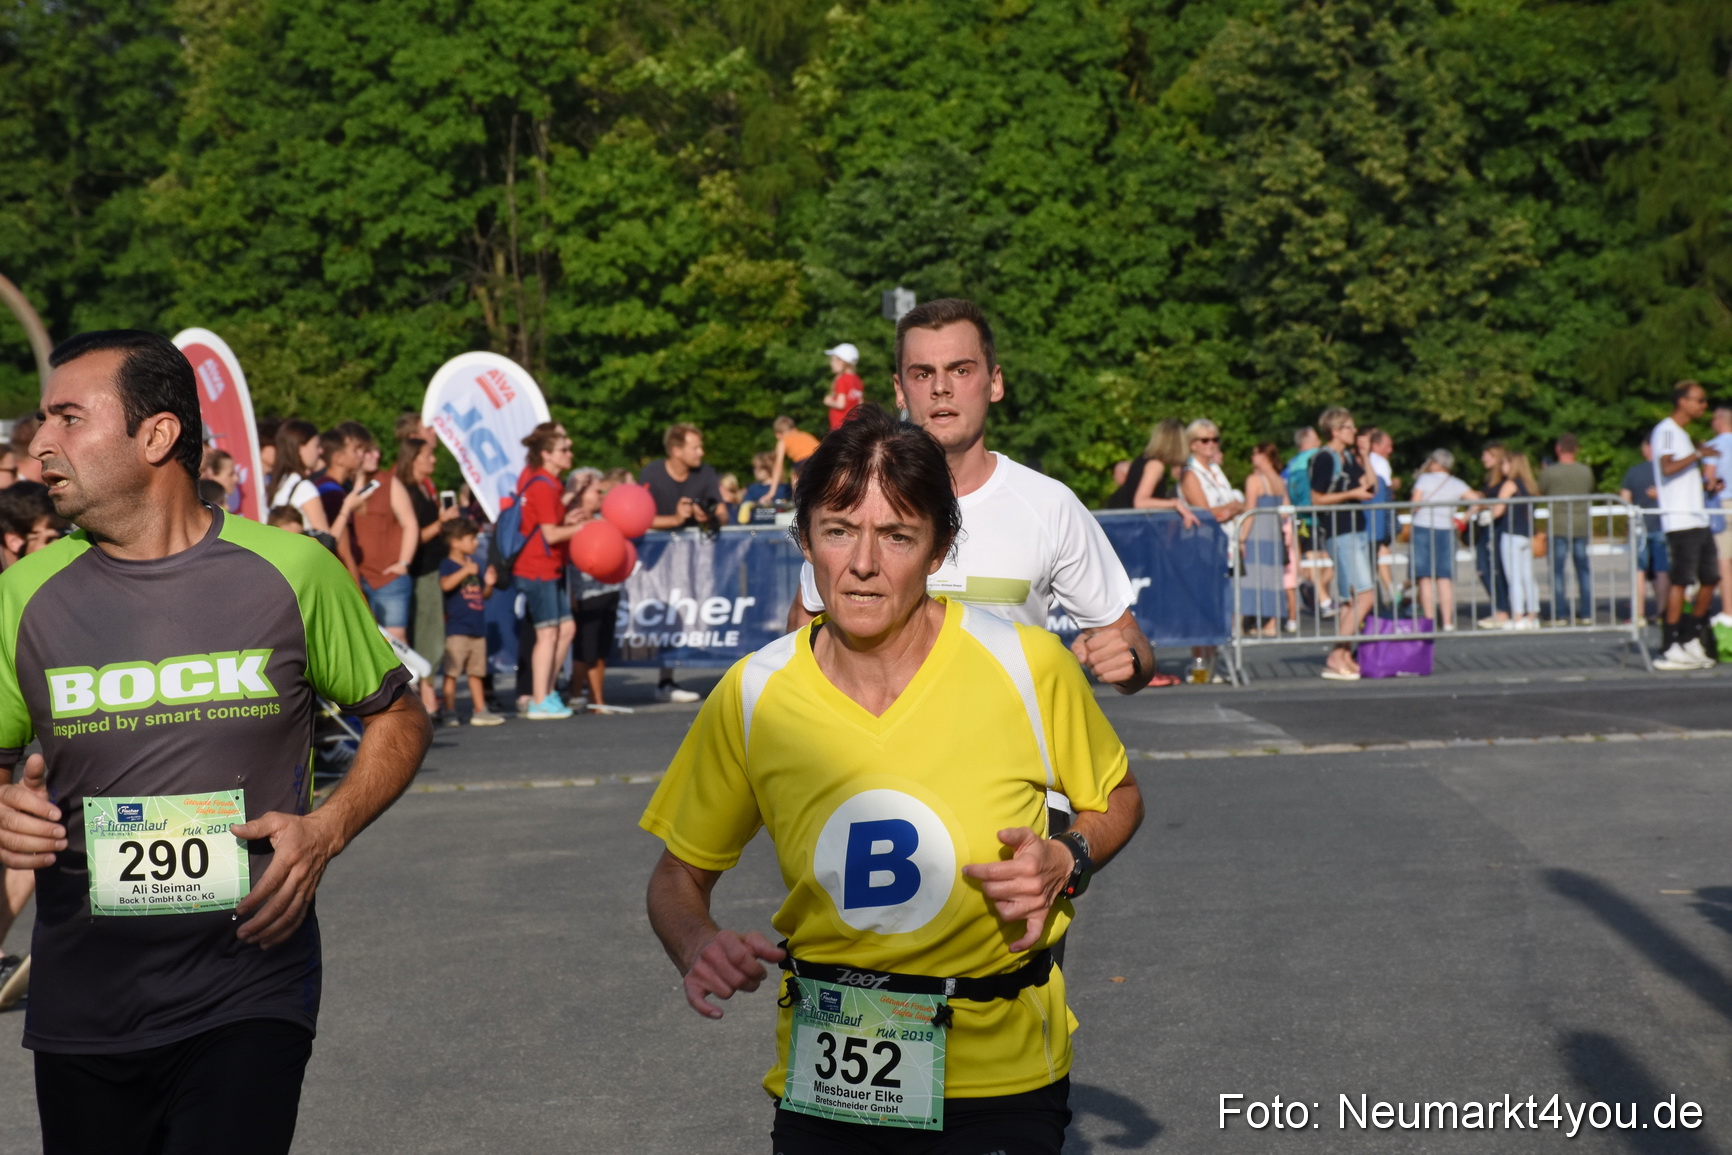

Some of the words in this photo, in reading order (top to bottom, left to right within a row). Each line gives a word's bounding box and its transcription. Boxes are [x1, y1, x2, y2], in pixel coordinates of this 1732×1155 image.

[49, 654, 271, 713] BOCK
[53, 716, 111, 740] inspired
[116, 714, 139, 732] by
[145, 707, 201, 726] smart
[207, 702, 281, 720] concepts
[107, 819, 168, 832] firmenlauf
[182, 826, 202, 836] run
[118, 837, 210, 882] 290
[844, 818, 922, 910] B
[119, 896, 140, 905] Bock
[142, 896, 146, 905] 1
[148, 895, 175, 905] GmbH
[176, 894, 184, 903] &
[185, 894, 200, 903] Co.
[202, 892, 216, 901] KG
[132, 884, 148, 895] Ali
[151, 882, 201, 894] Sleiman
[809, 1005, 864, 1028] firmenlauf
[876, 1027, 898, 1040] run
[901, 1029, 934, 1042] 2019
[814, 1031, 903, 1089] 352
[813, 1080, 872, 1101] Miesbauer
[874, 1090, 904, 1104] Elke
[815, 1095, 868, 1112] Bretschneider
[870, 1103, 900, 1114] GmbH
